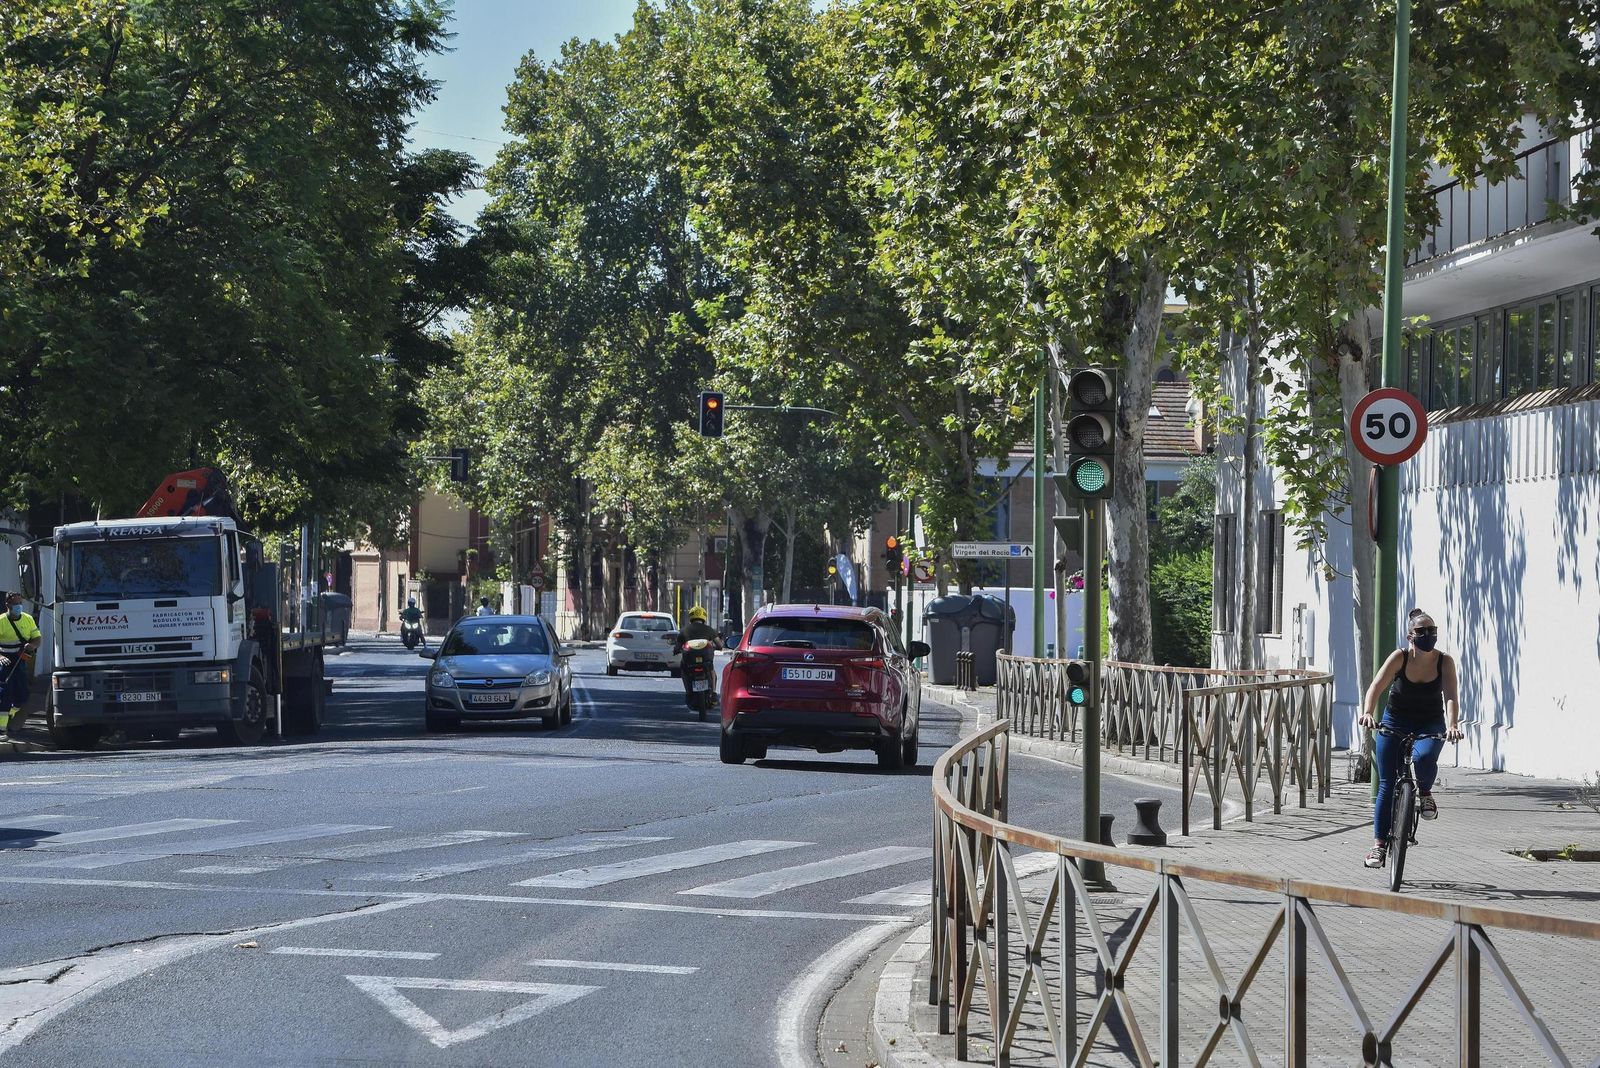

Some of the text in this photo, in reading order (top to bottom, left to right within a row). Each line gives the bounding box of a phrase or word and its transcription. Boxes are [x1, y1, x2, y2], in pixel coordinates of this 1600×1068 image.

[1366, 412, 1411, 440] 50
[109, 526, 163, 537] REMSA
[77, 615, 129, 626] REMSA
[77, 624, 129, 632] www.remsa.net
[121, 644, 156, 654] IVECO
[788, 669, 833, 680] 5510 JBM
[122, 693, 142, 702] 8230
